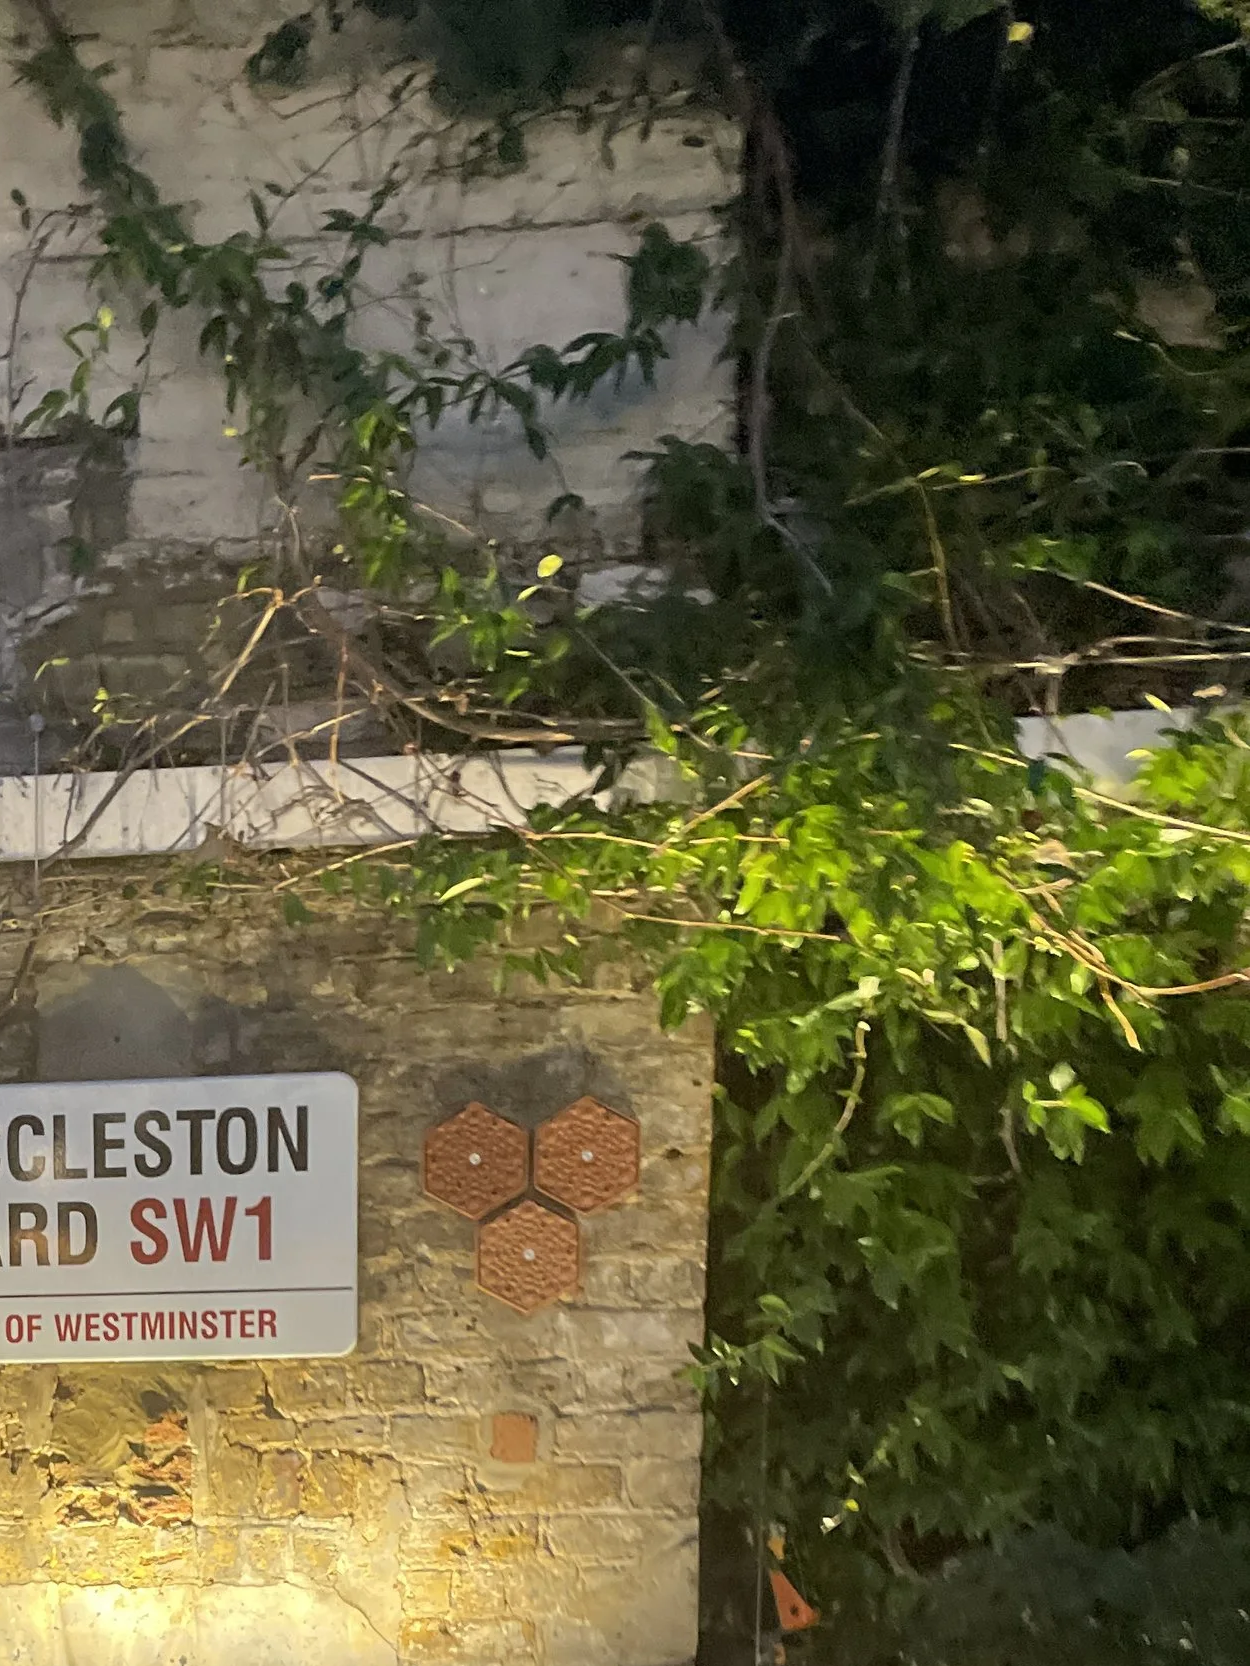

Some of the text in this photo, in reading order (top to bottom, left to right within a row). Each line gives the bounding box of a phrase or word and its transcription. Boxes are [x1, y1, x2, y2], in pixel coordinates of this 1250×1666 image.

[130, 1196, 273, 1265] SW1
[6, 1314, 42, 1343] OF
[54, 1309, 278, 1342] WESTMINSTER
